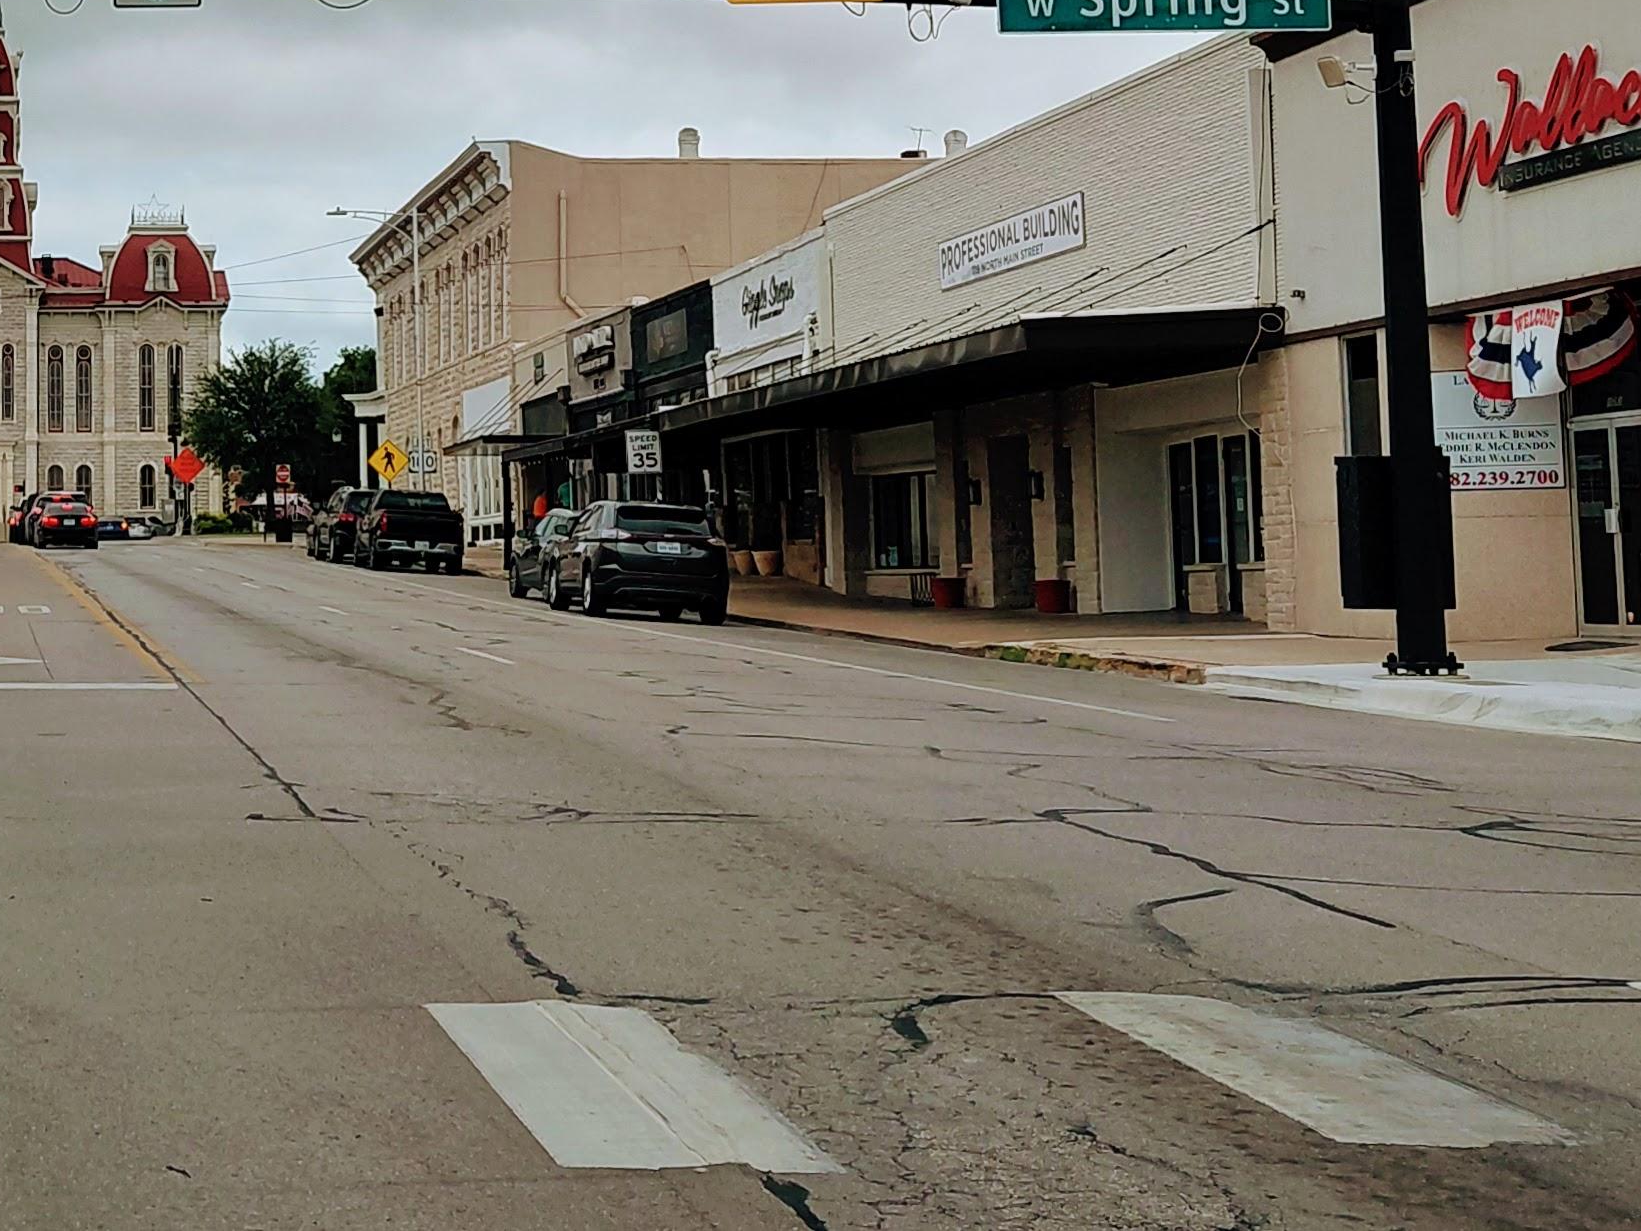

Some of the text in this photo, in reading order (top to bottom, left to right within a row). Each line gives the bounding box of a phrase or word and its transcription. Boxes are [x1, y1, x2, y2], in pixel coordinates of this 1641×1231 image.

[1499, 151, 1583, 186] INSURANCE
[940, 200, 1080, 280] PROFESSIONAL BUILDING
[1020, 242, 1044, 260] STREET
[1514, 307, 1560, 333] WELCOME
[629, 434, 658, 443] SPEED
[1513, 429, 1550, 440] BURNS
[632, 443, 655, 451] LIMIT
[633, 452, 658, 469] 35
[1488, 453, 1537, 463] WALDEN
